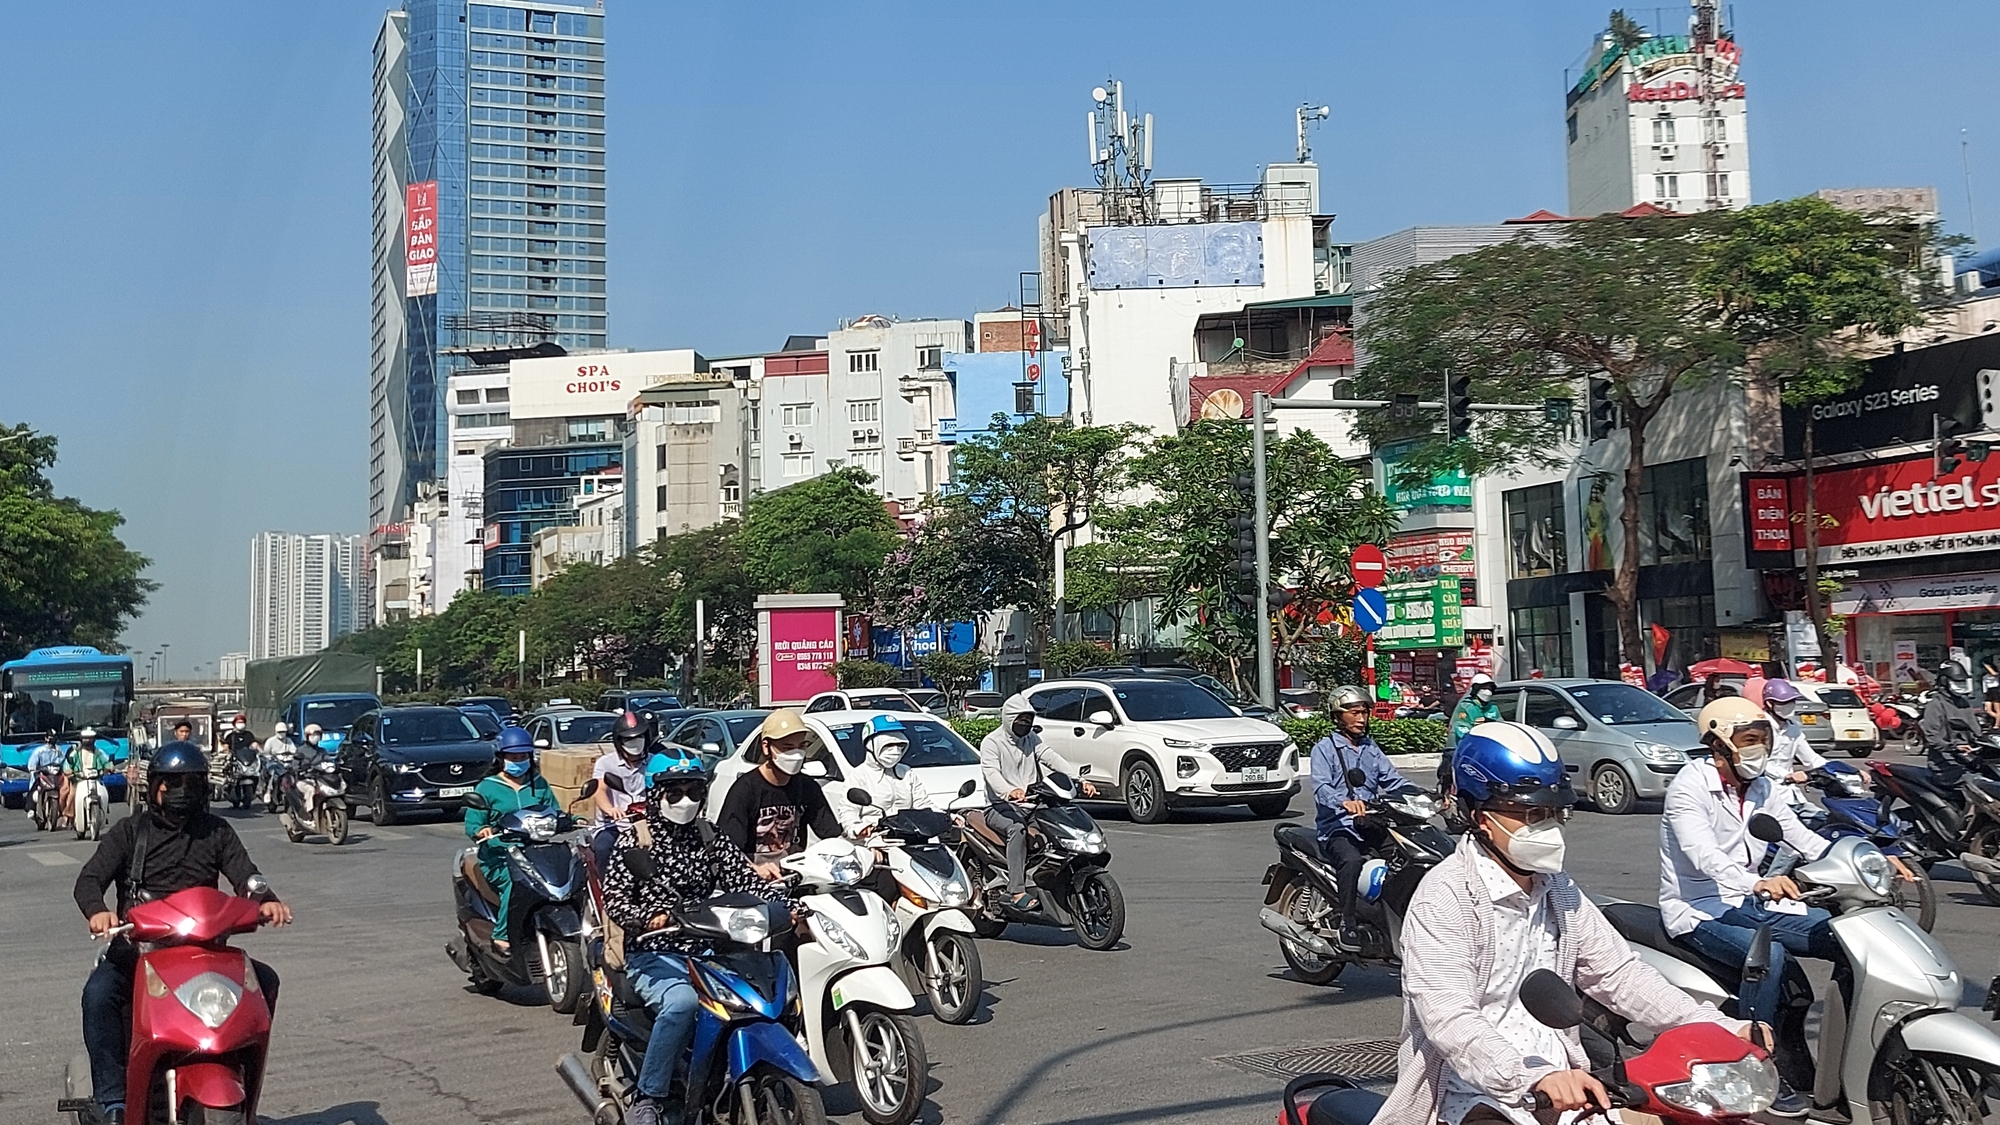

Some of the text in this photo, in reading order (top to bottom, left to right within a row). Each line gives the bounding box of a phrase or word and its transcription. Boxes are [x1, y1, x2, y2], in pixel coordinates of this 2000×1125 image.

[408, 248, 435, 261] GIAO
[577, 364, 610, 378] SPA
[565, 379, 622, 394] CHOI'S
[1811, 383, 1939, 420] Galaxy S23 Series
[1757, 484, 1782, 499] BÁN
[1858, 475, 1981, 518] viettel
